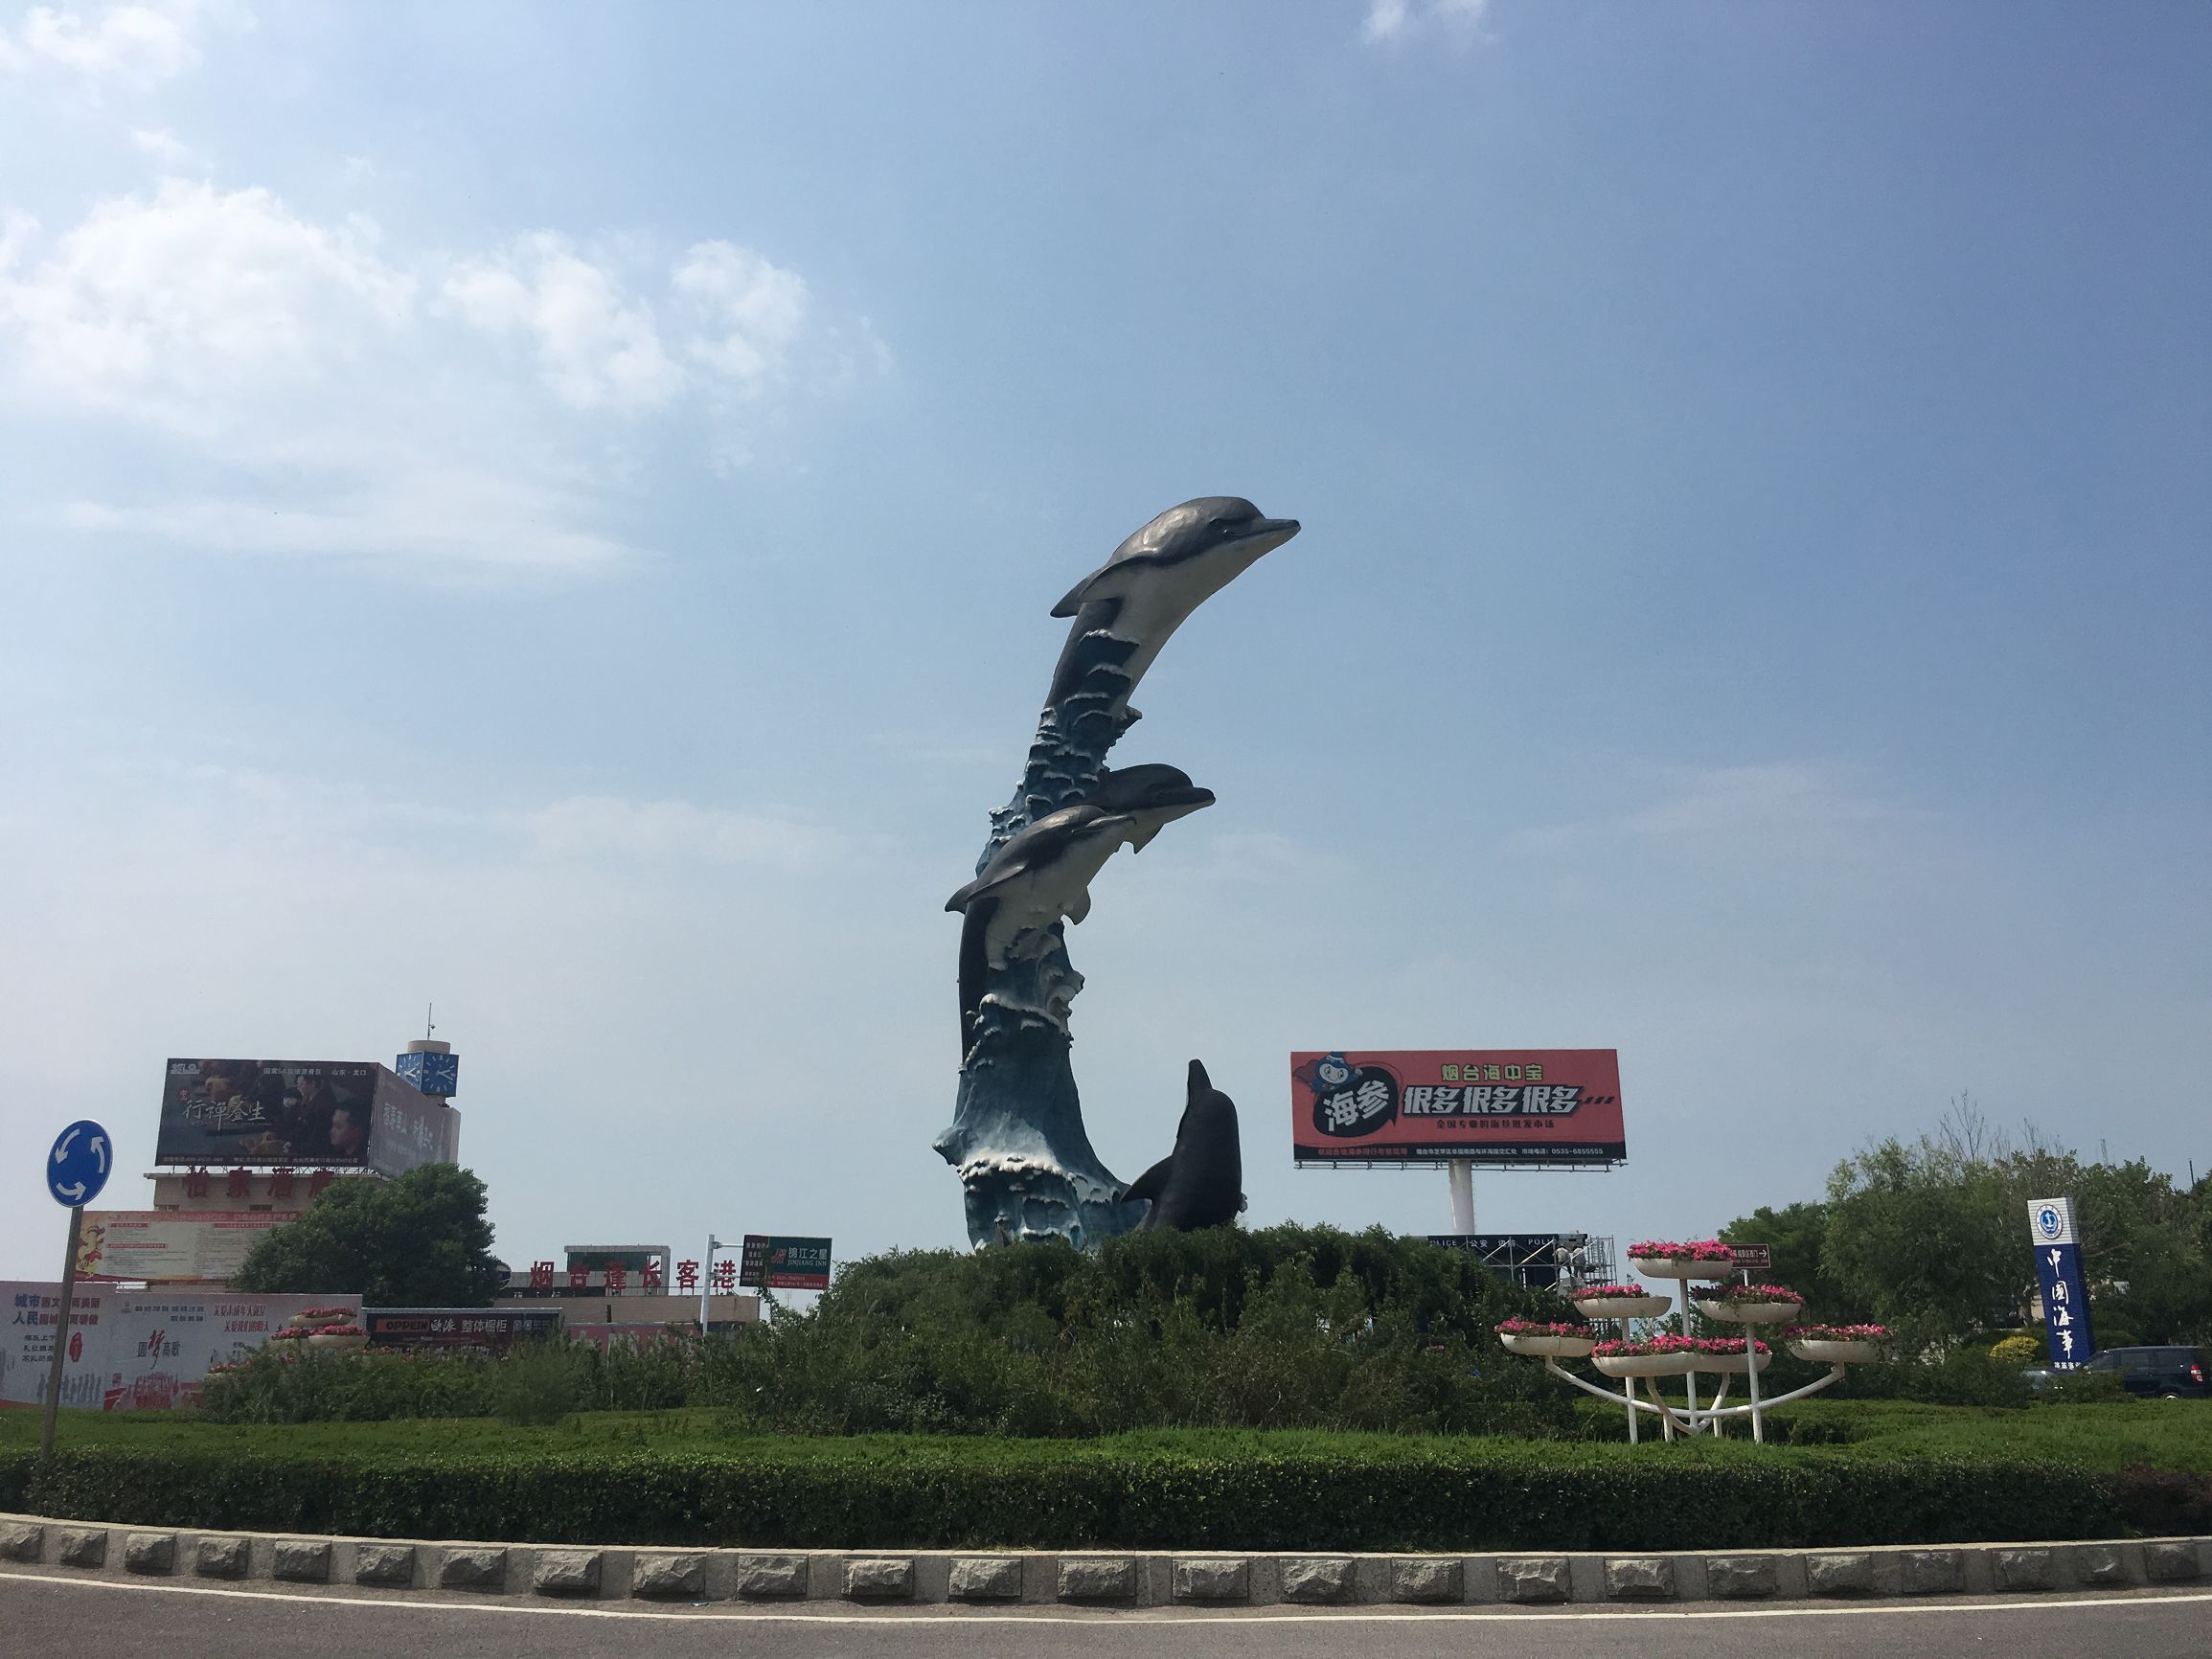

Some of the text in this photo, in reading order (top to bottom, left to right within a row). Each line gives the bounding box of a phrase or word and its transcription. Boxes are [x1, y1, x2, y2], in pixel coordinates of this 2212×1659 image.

[1441, 1063, 1544, 1082] 烟台海中宝
[1323, 1079, 1389, 1132] 海参
[1471, 1239, 1488, 1248] 公安
[787, 1246, 828, 1261] 锦江之星
[787, 1259, 813, 1267] JINJIANG
[530, 1259, 737, 1290] 烟台蓬长客港
[385, 1321, 428, 1330] OPPEIN
[461, 1319, 508, 1333] 整体橱柜
